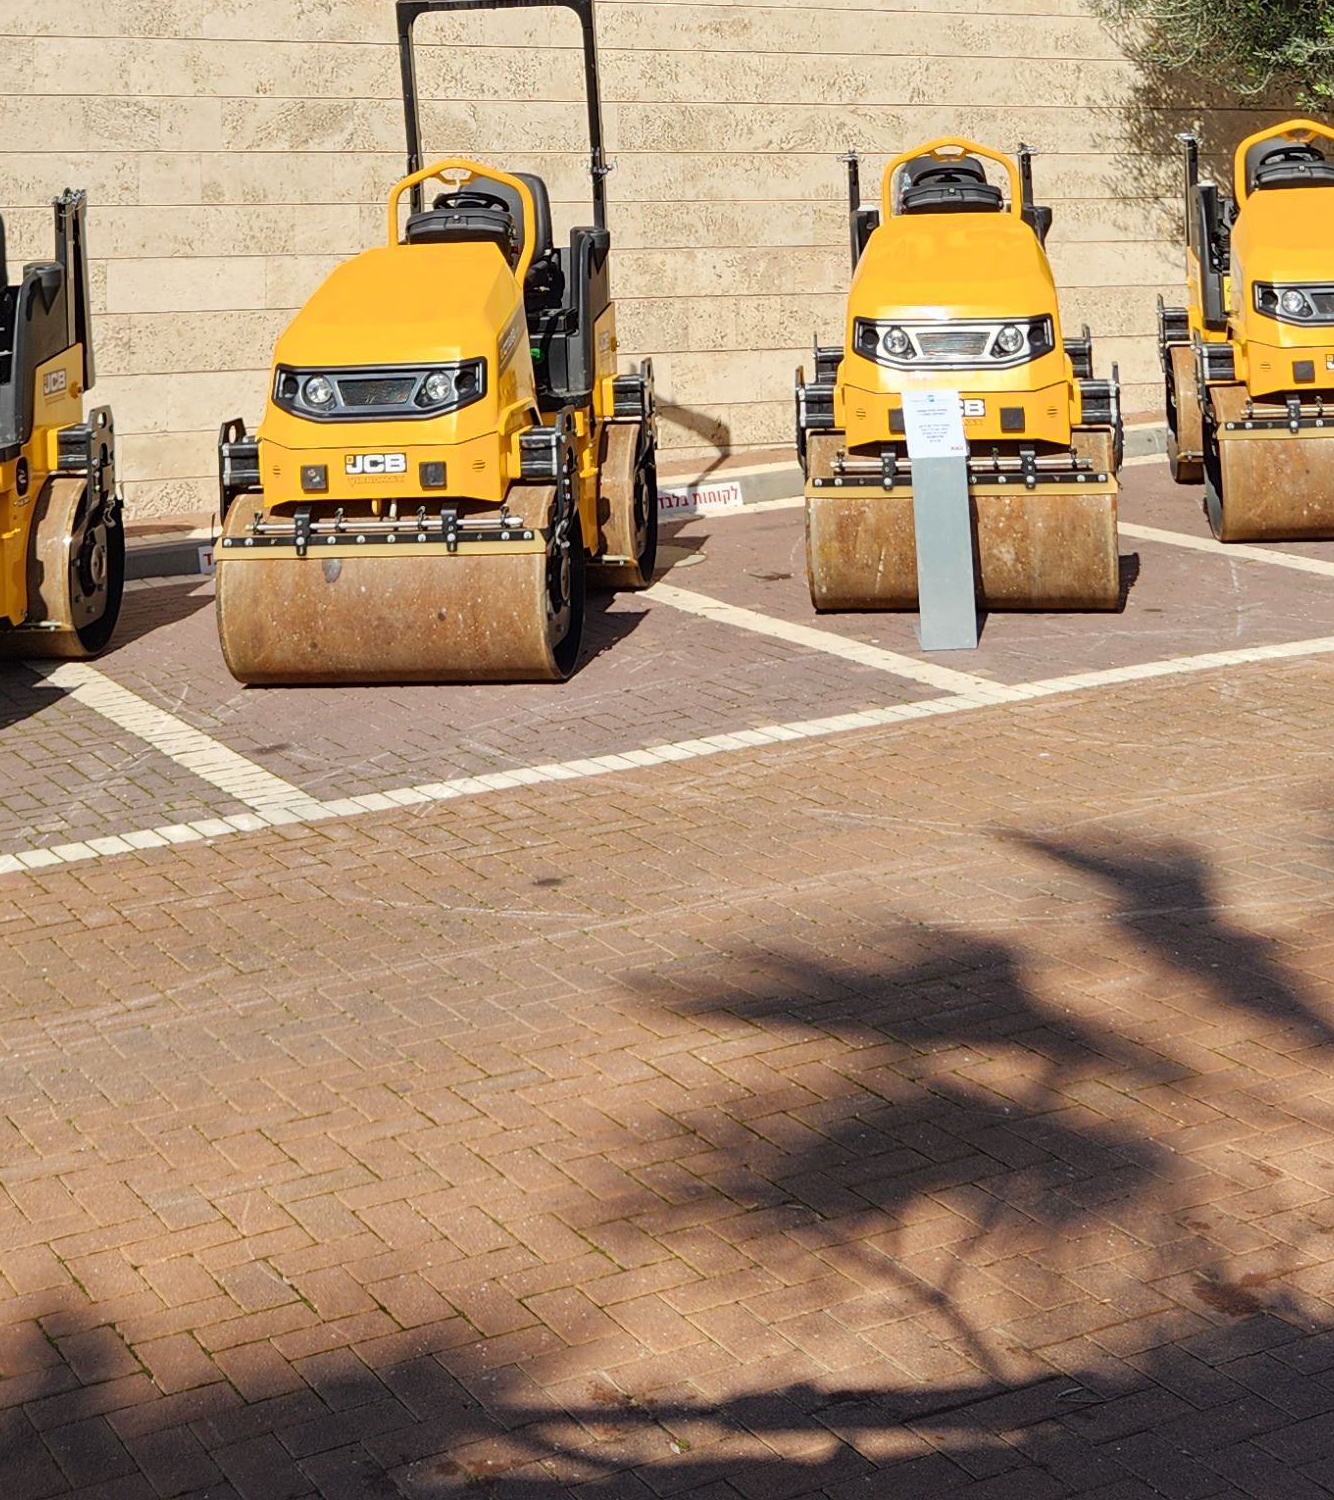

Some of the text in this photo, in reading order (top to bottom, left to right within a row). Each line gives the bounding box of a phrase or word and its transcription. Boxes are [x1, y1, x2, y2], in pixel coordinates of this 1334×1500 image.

[43, 370, 67, 394] JCB
[346, 453, 407, 474] JCB
[658, 485, 739, 509] לקוחות בלבד
